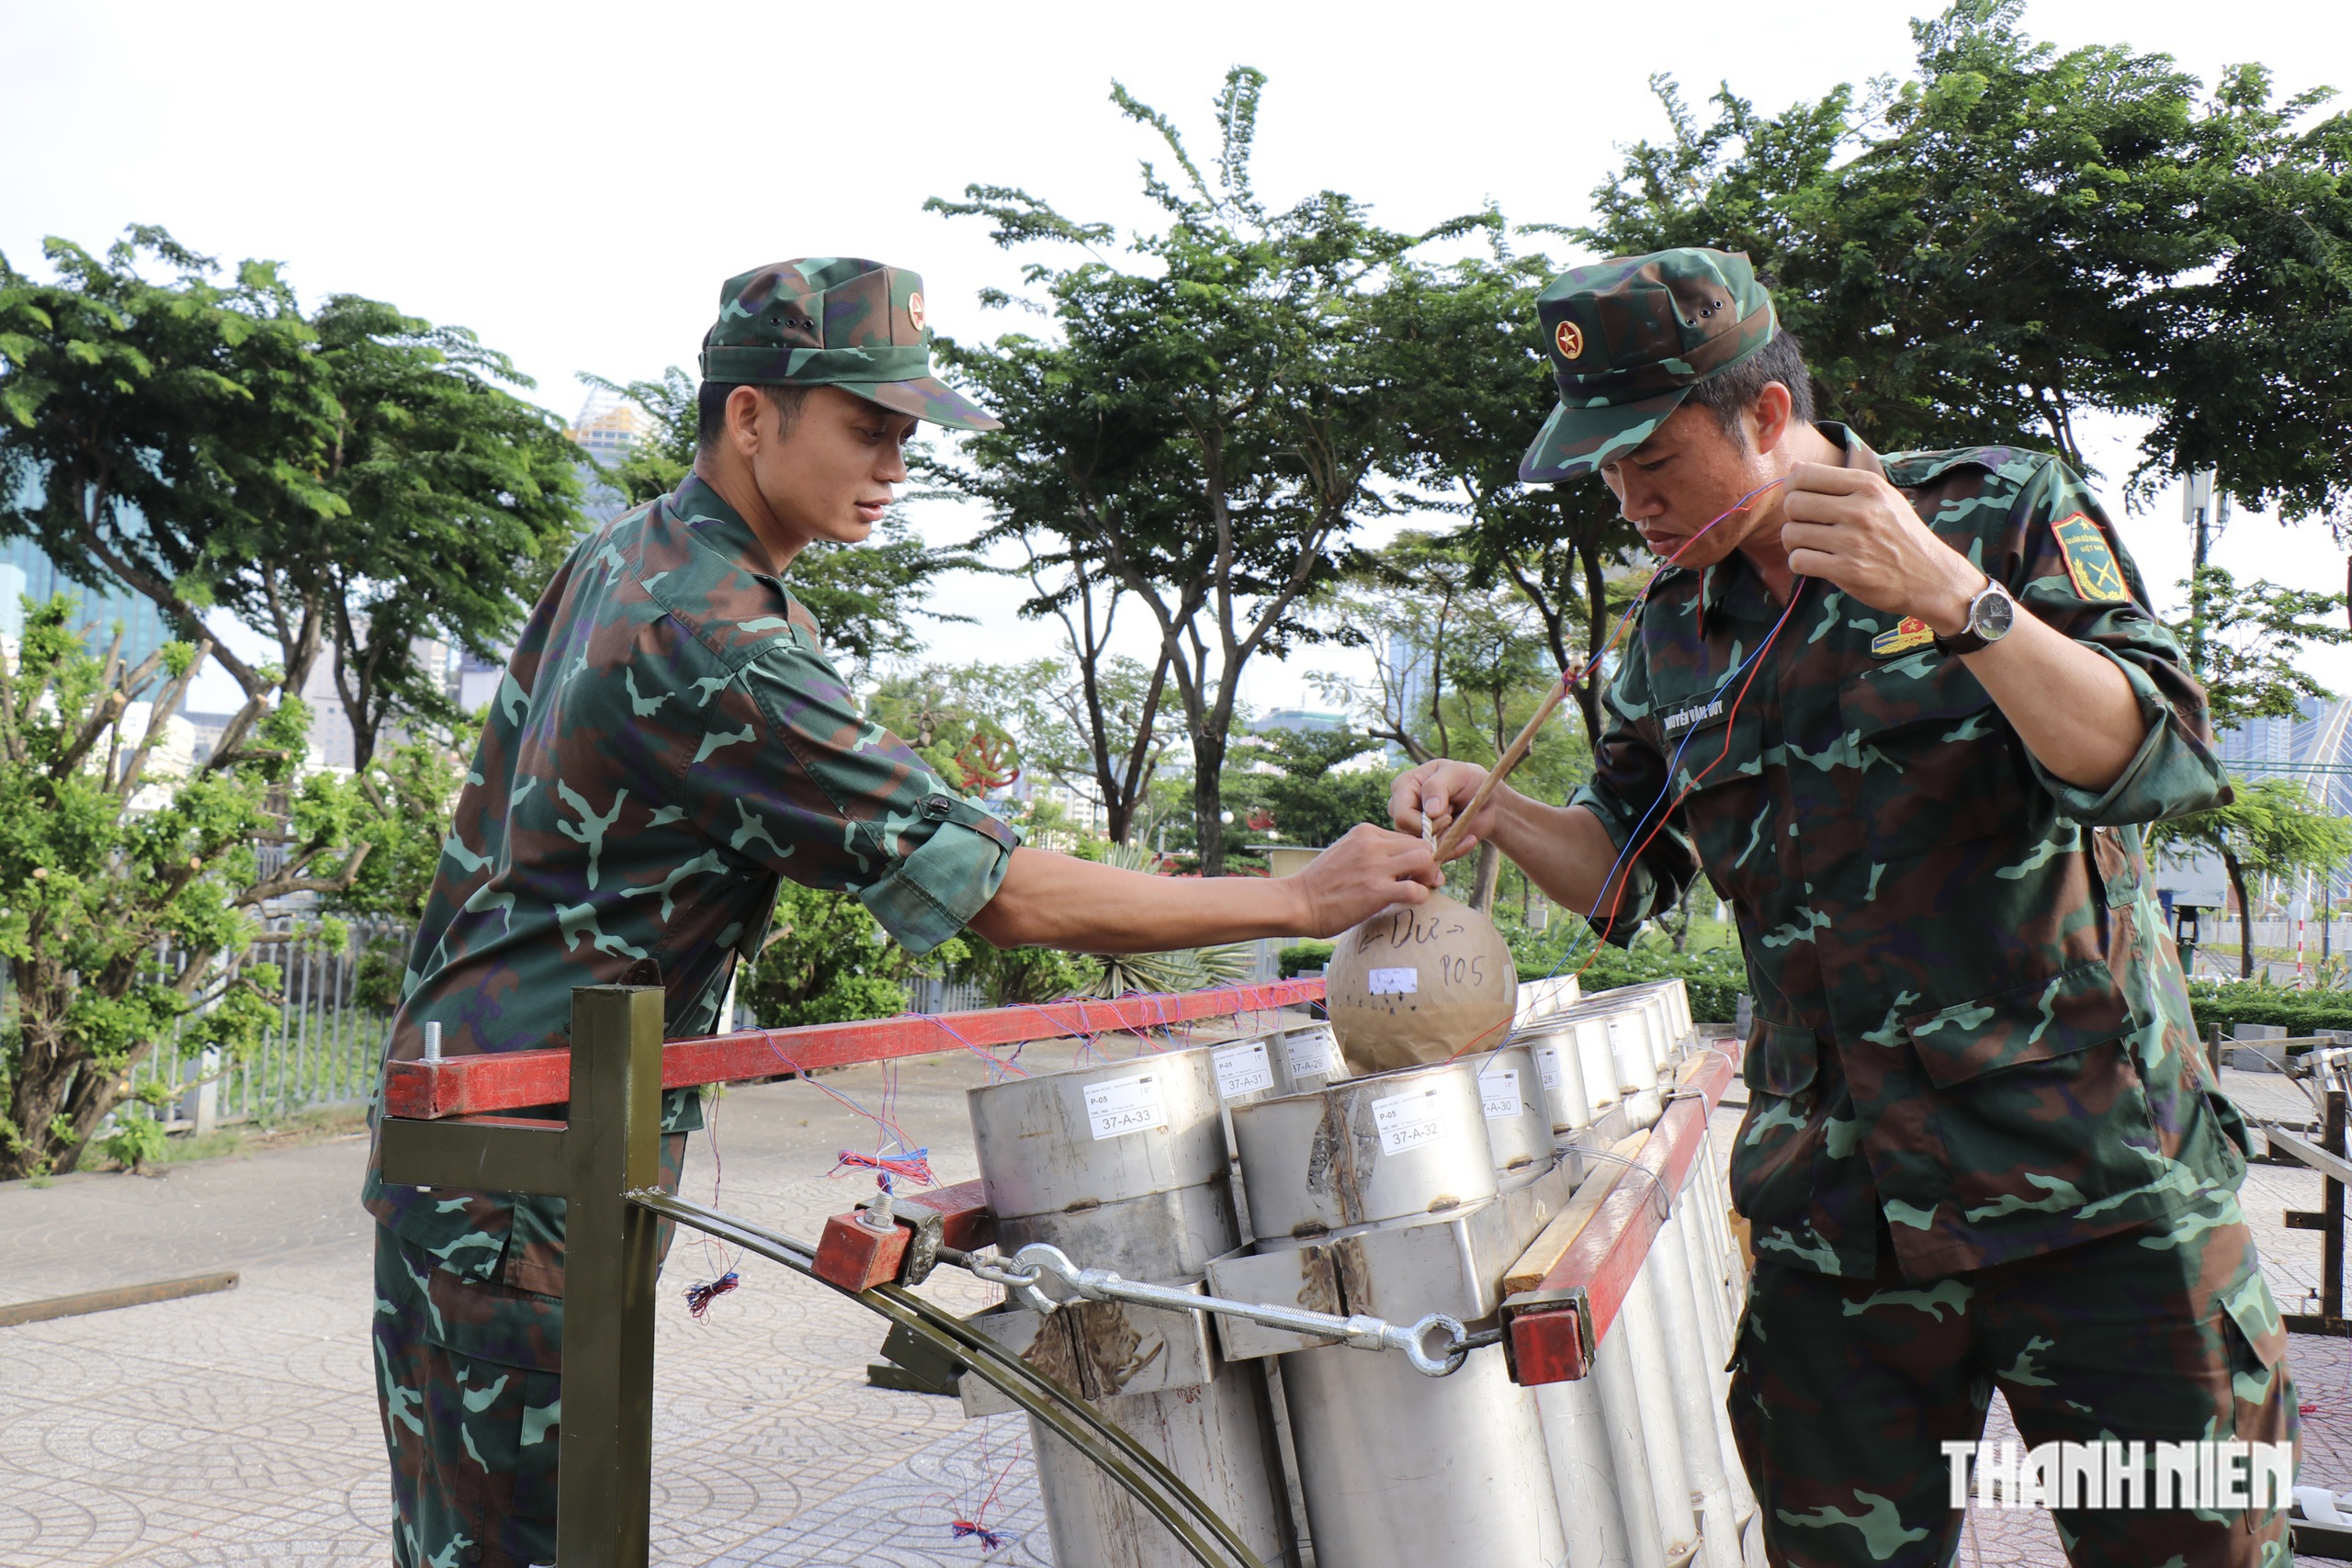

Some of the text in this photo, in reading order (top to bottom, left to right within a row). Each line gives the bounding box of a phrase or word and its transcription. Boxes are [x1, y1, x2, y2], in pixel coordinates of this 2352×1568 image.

[1228, 1074, 1263, 1090] 37-A-31
[1543, 1074, 1554, 1084] 28
[1091, 1096, 1108, 1105] P-05
[1483, 1100, 1511, 1112] -A-30
[1102, 1110, 1151, 1130] 37-A-33
[1379, 1110, 1396, 1121] P-05
[1392, 1122, 1438, 1145] 37-A-32
